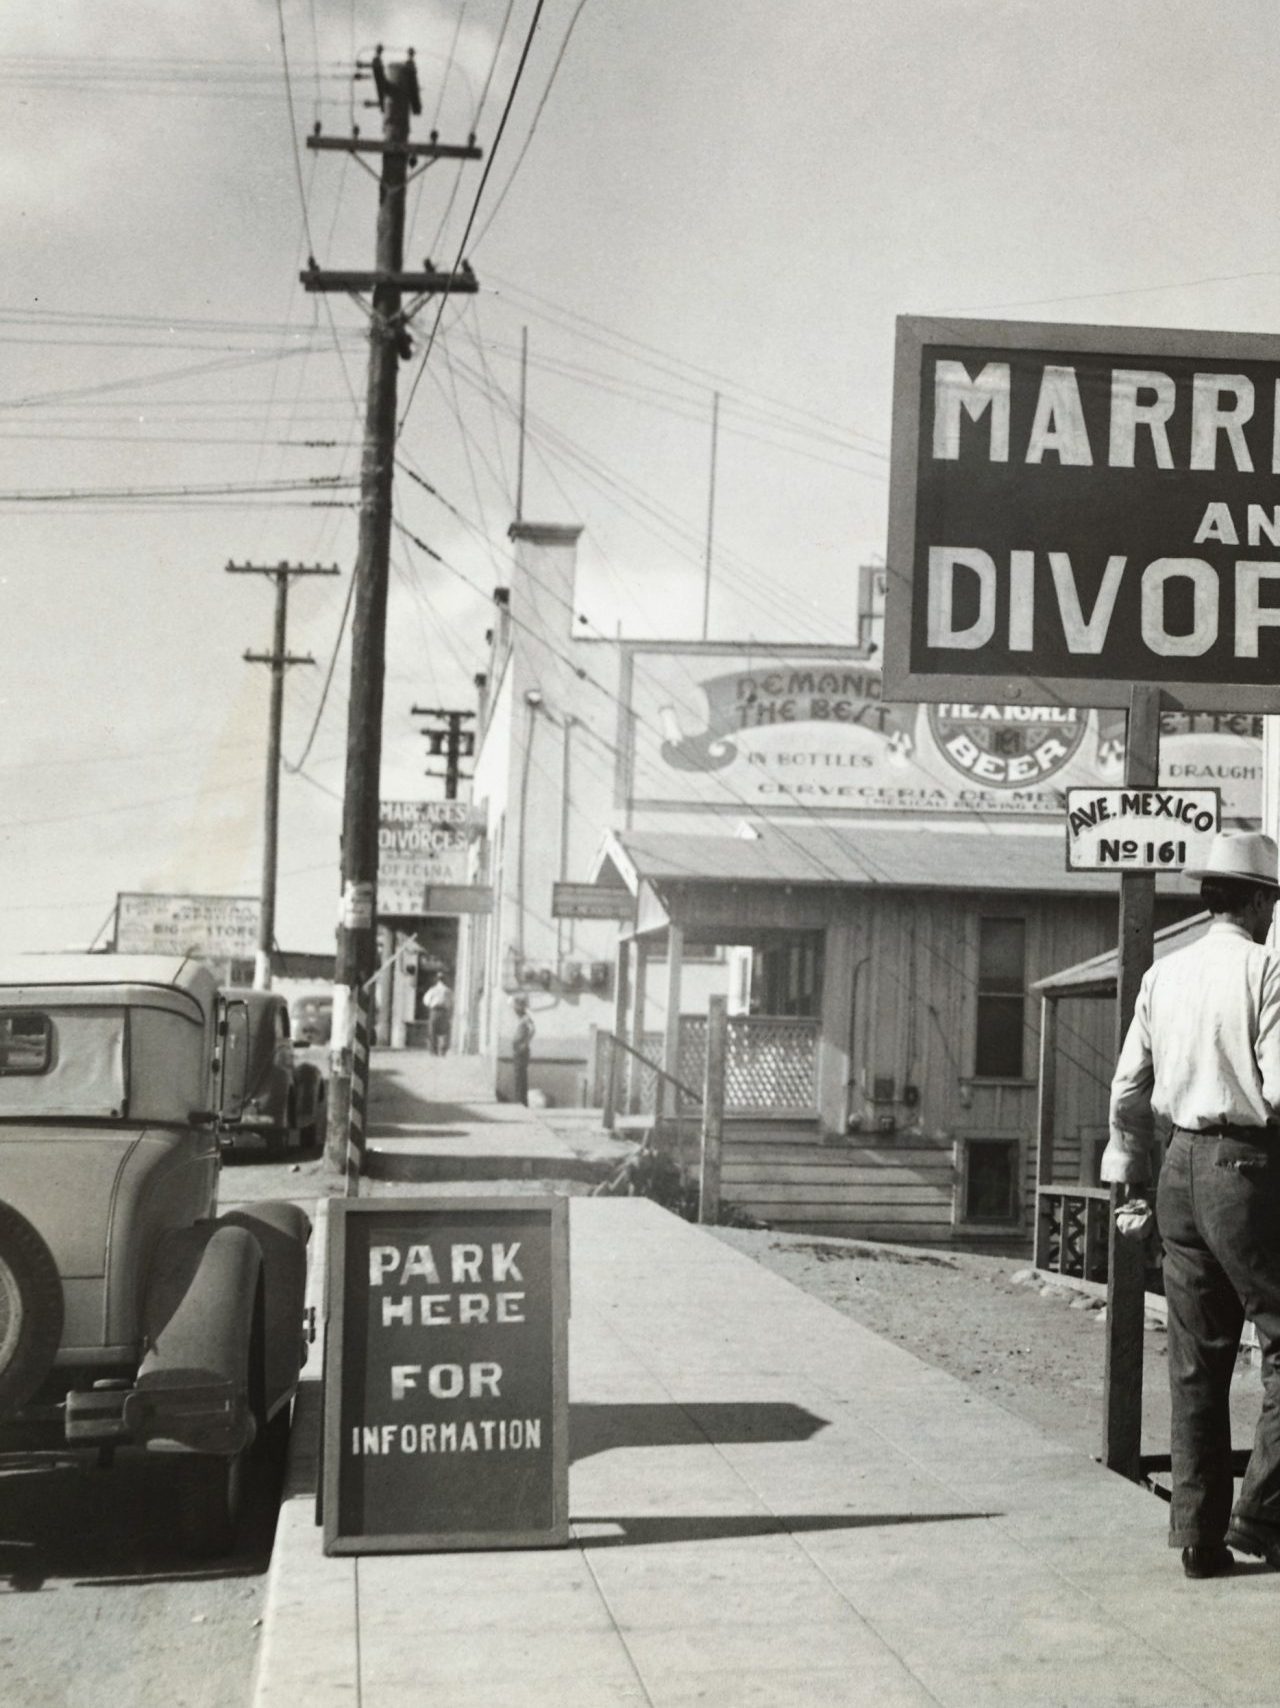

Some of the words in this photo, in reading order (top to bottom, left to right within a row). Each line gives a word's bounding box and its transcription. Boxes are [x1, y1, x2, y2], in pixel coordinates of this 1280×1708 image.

[735, 700, 796, 728] THE
[809, 699, 892, 732] BEST
[778, 753, 873, 768] BOTTLES
[946, 734, 1067, 782] BEER
[757, 783, 945, 800] CERVECERIA
[1069, 797, 1118, 837] AVE.
[1121, 793, 1214, 832] MEXICO
[1146, 840, 1186, 864] 161
[368, 1241, 525, 1287] PARK
[381, 1291, 527, 1328] HERE
[390, 1361, 503, 1401] FOR
[351, 1418, 542, 1455] INFORMATION
